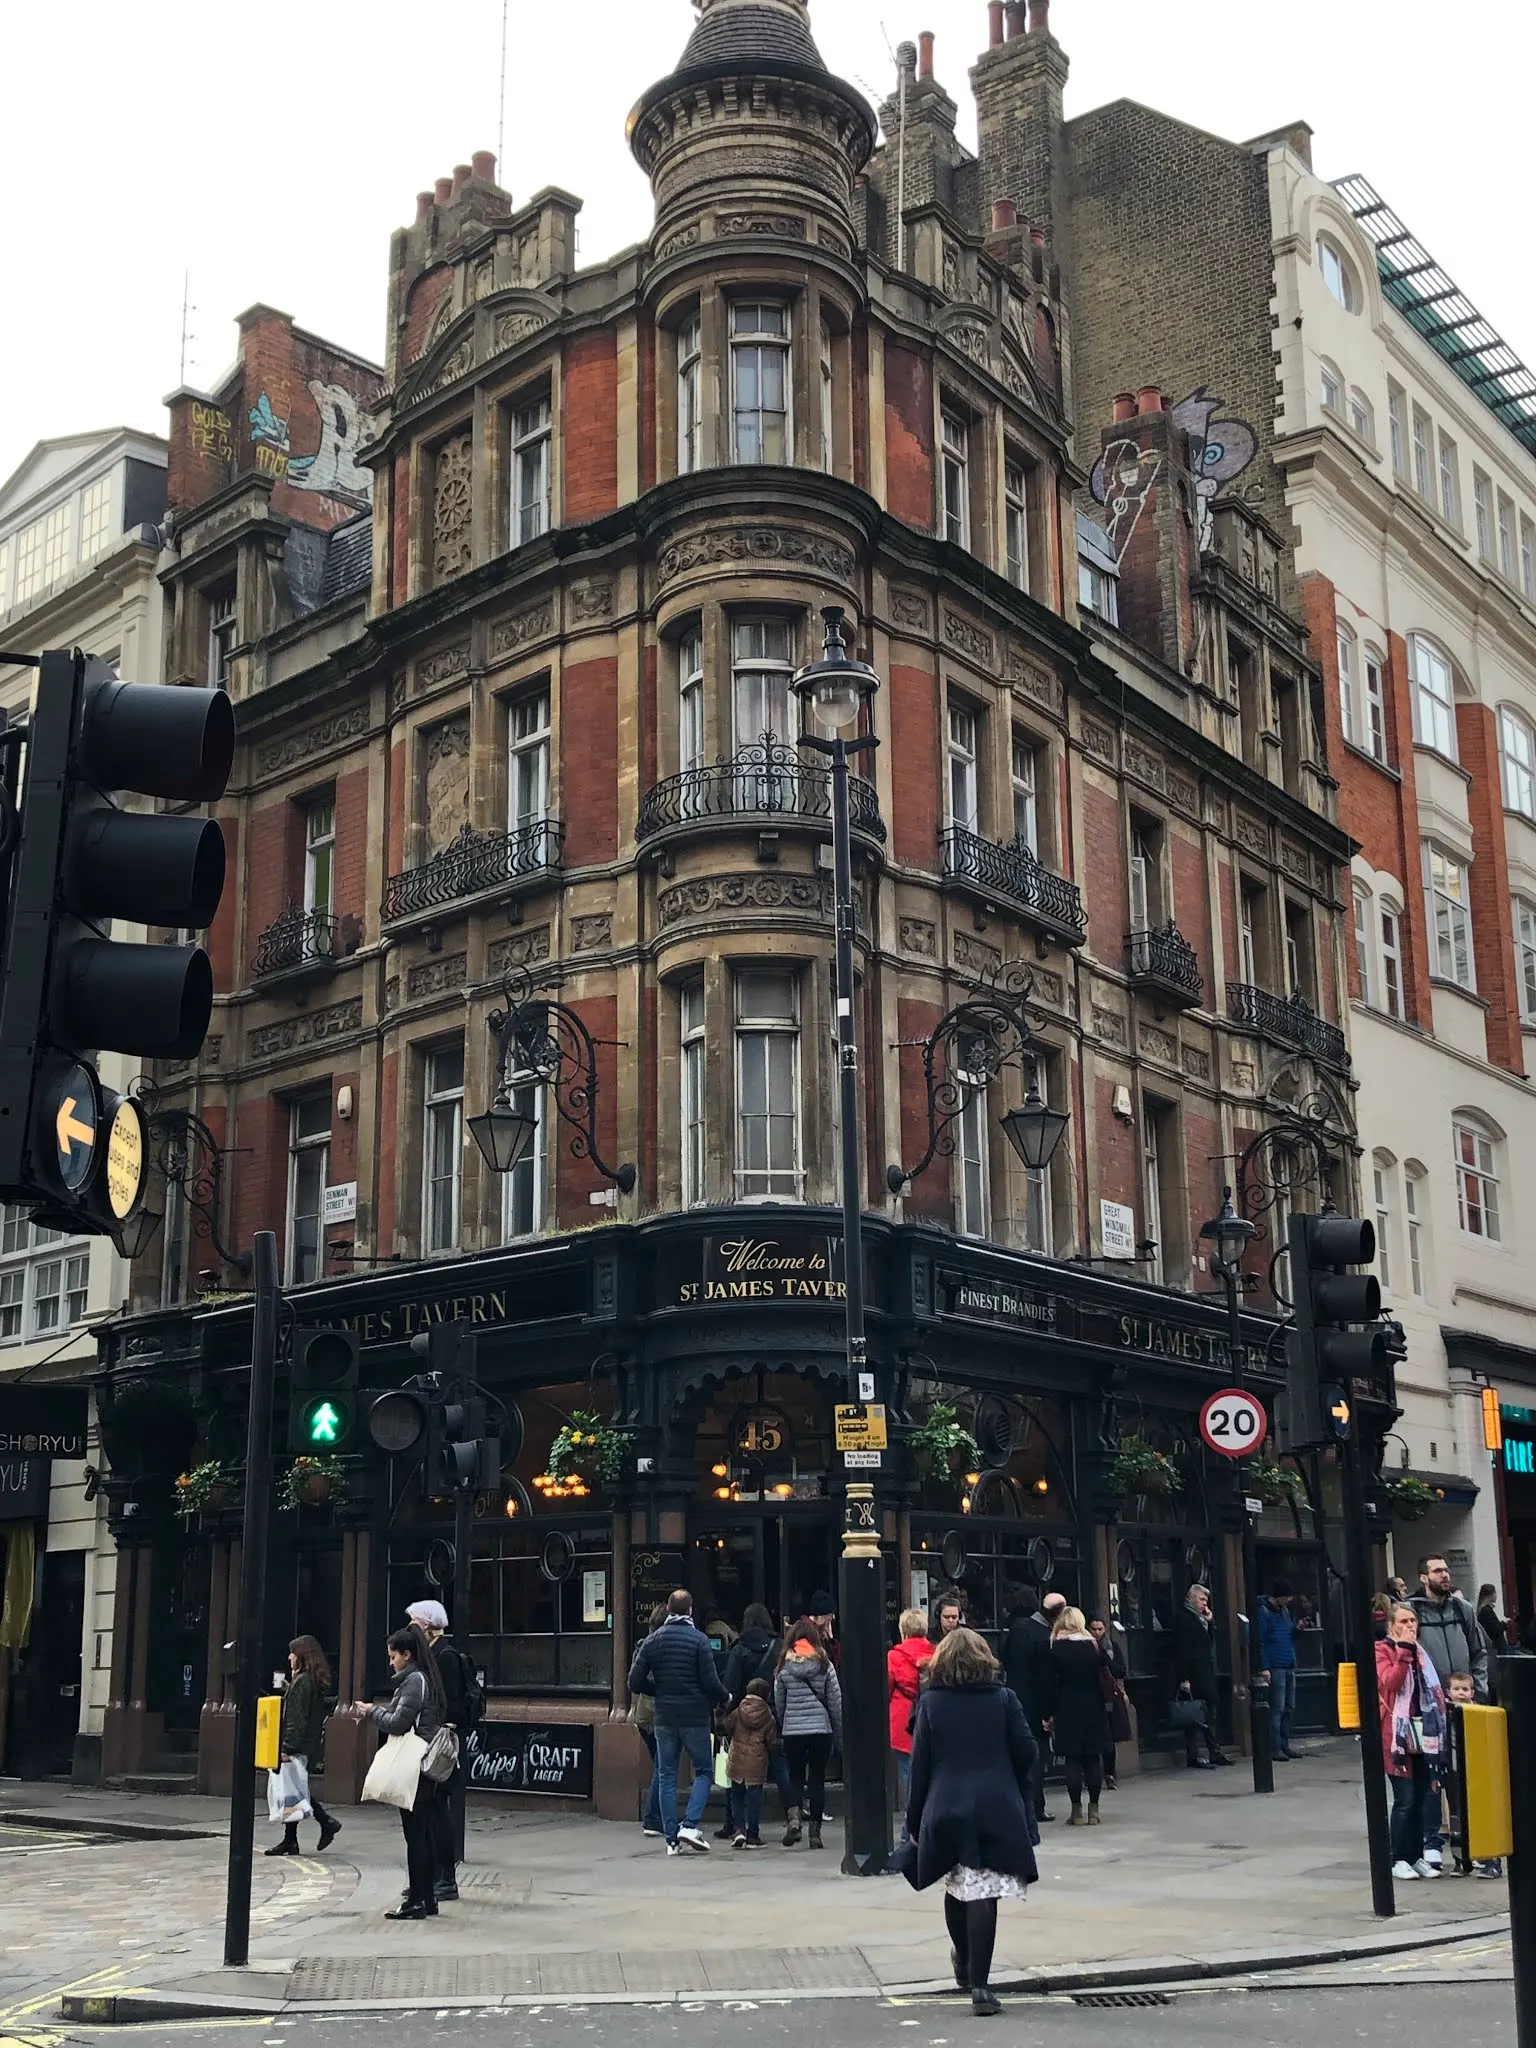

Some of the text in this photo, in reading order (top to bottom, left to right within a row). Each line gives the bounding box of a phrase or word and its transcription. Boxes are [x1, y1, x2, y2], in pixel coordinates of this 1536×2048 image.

[114, 1115, 138, 1152] Except
[109, 1149, 139, 1181] uses and
[325, 1199, 344, 1210] STREET
[326, 1188, 348, 1200] DENMAN
[1103, 1204, 1121, 1218] GREAT
[1104, 1218, 1131, 1236] WINDMILL
[1104, 1231, 1124, 1246] STREET
[720, 1239, 827, 1272] Welcome to
[704, 1280, 774, 1300] JAMES
[781, 1278, 847, 1298] TAVER
[315, 1310, 392, 1341] MES
[401, 1289, 507, 1334] TAVERN
[959, 1287, 1055, 1322] FINEST BRANDIES
[1144, 1322, 1201, 1360] JAMES
[1206, 1333, 1268, 1372] TARN
[739, 1420, 781, 1451] 45
[1210, 1409, 1256, 1436] 20
[1505, 1439, 1535, 1472] FIRE
[867, 1558, 874, 1569] 4
[471, 1752, 517, 1781] Chips
[529, 1743, 581, 1768] CRAFT
